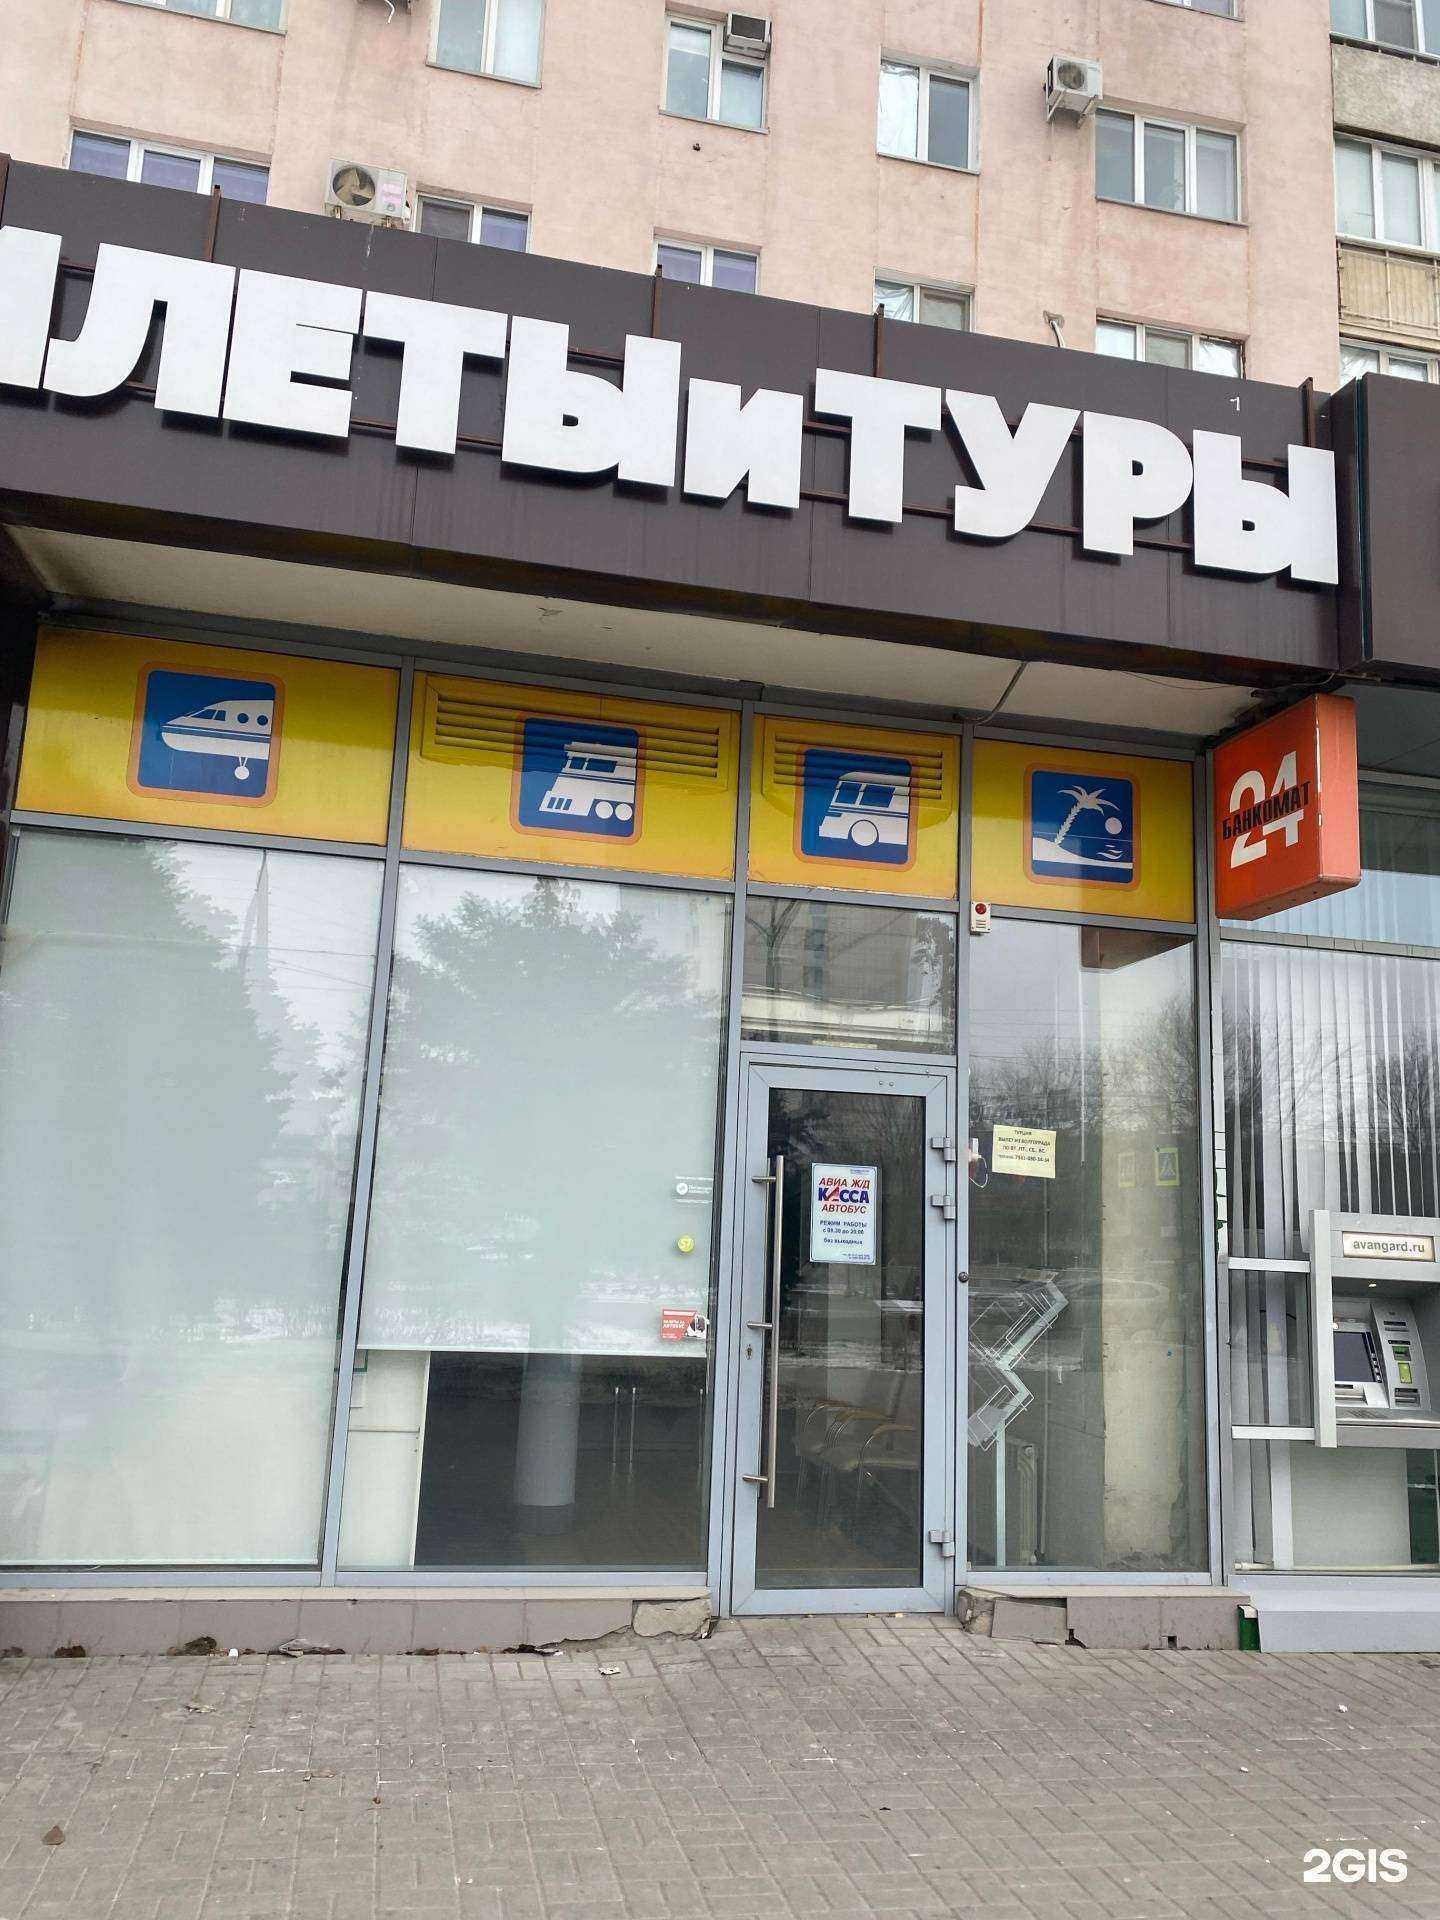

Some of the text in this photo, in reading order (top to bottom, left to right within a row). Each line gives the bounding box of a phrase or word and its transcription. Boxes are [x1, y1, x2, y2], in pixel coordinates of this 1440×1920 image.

[1222, 780, 1311, 841] БАНКОМАТ
[1229, 750, 1304, 869] 24
[818, 1177, 871, 1190] АВИА Ж/Д
[818, 1186, 870, 1204] КАССА
[821, 1203, 868, 1214] АВТОБУС
[1353, 1239, 1425, 1253] avangard.ru
